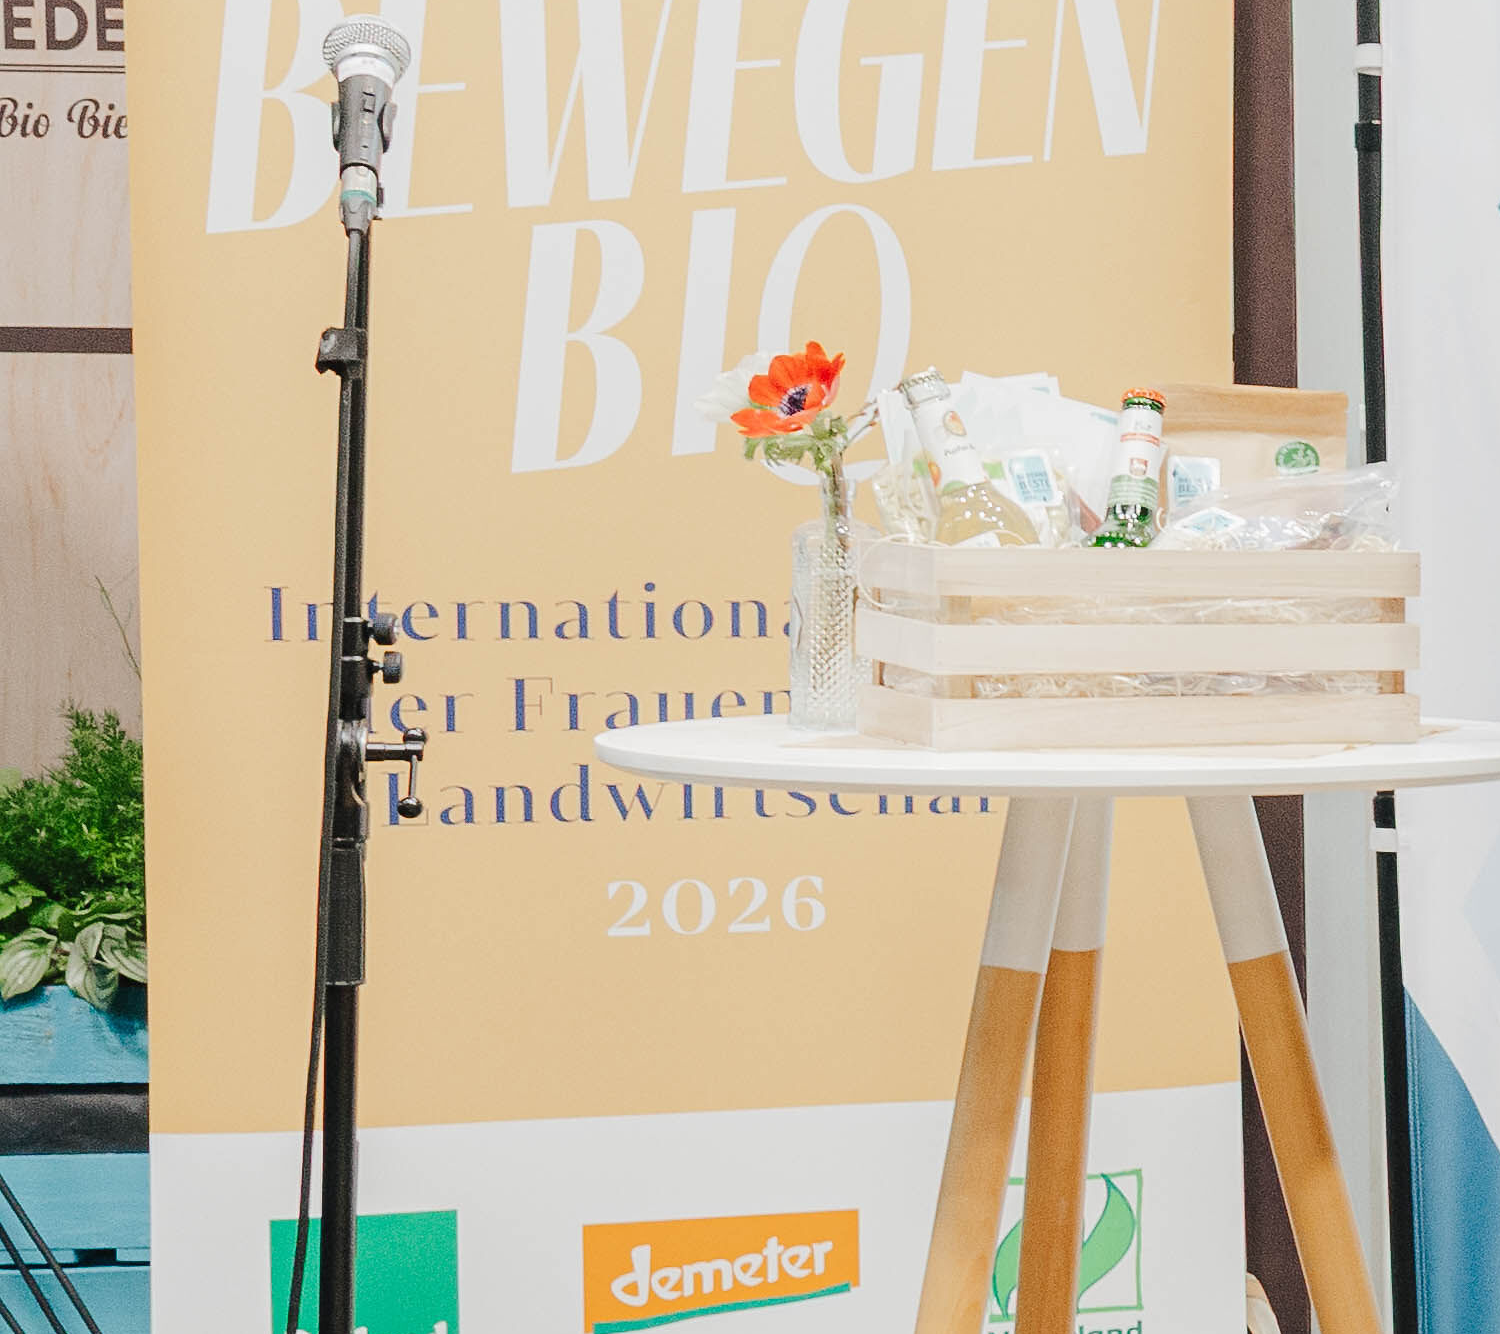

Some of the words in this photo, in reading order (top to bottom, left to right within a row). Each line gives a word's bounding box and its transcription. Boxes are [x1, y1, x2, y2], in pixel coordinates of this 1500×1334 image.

[67, 98, 128, 138] Bie
[511, 204, 912, 473] BIO
[366, 687, 474, 735] er
[607, 875, 826, 937] 2026
[610, 1236, 832, 1307] demeter
